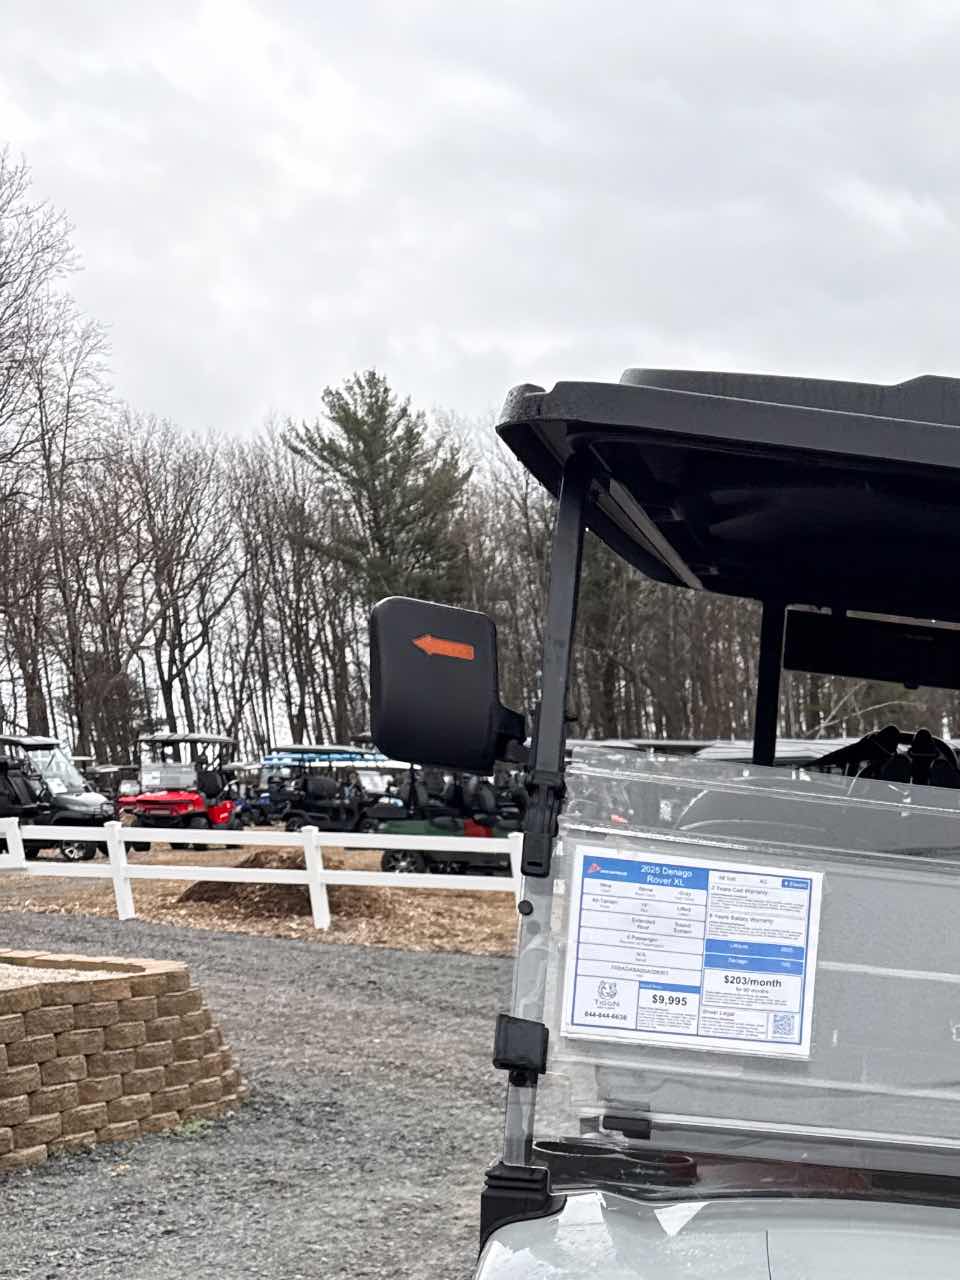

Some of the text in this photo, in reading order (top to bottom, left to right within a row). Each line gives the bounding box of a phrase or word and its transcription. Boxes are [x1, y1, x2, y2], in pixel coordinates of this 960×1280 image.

[640, 864, 660, 874] 2025
[662, 865, 693, 878] Denago
[647, 874, 685, 886] Rover XL
[724, 974, 782, 988] $203/month
[652, 993, 688, 1007] $9,995
